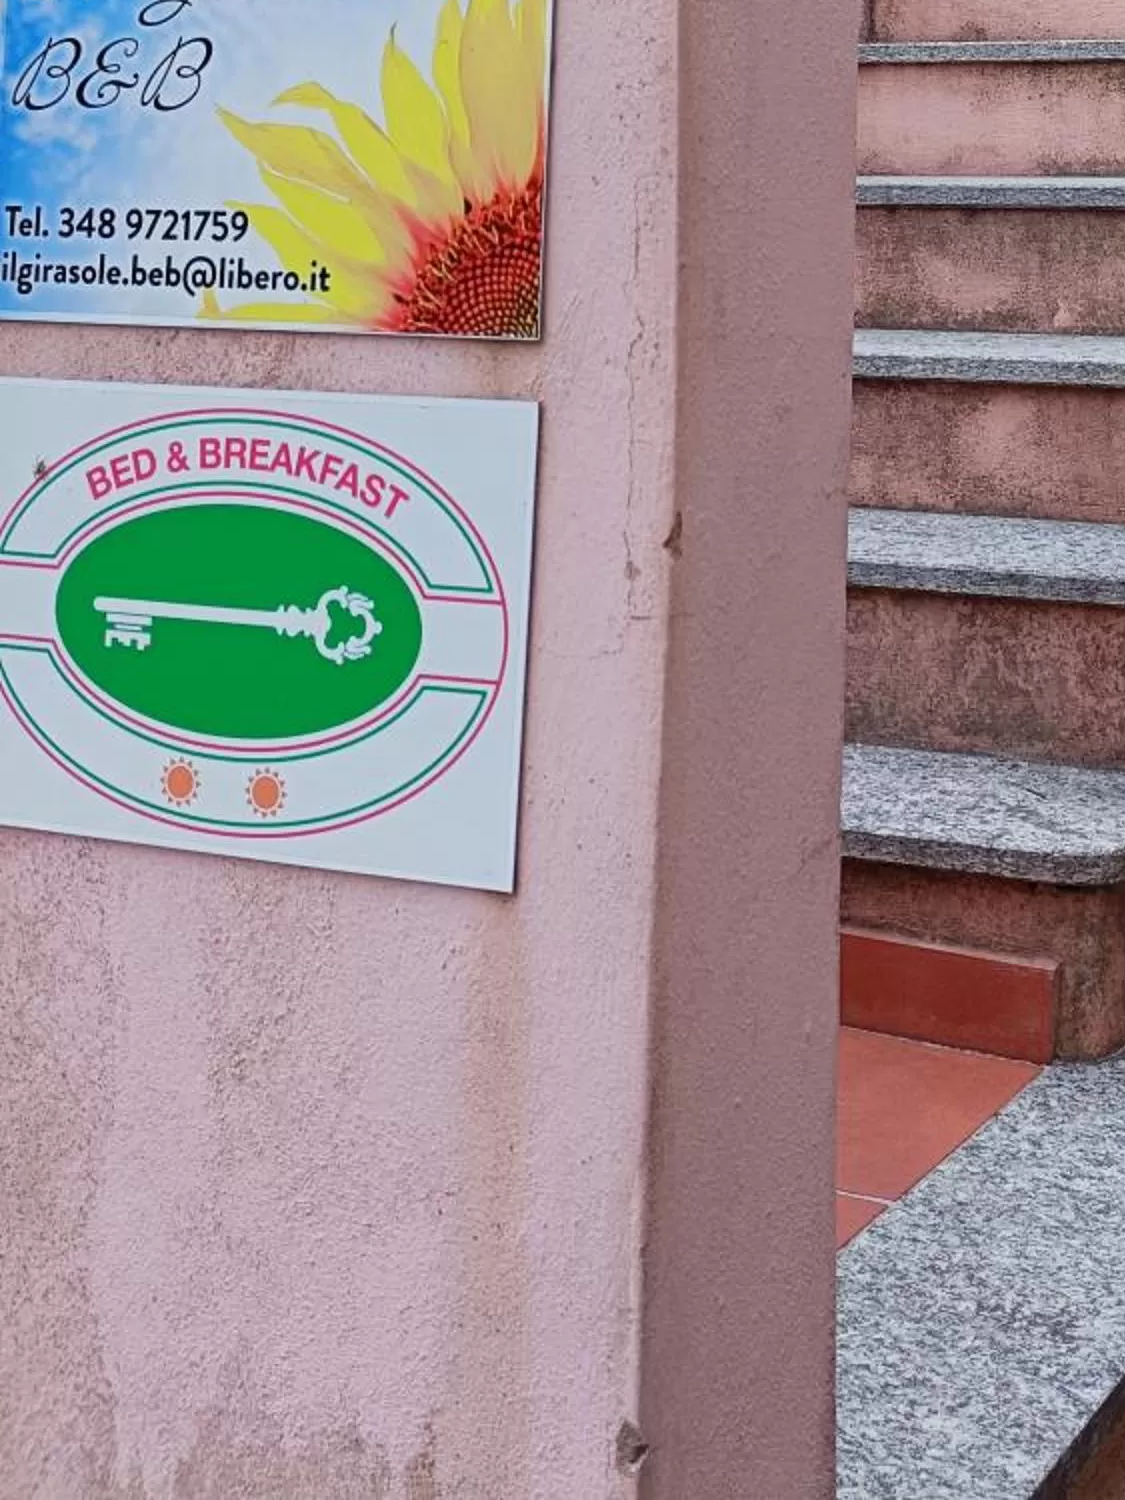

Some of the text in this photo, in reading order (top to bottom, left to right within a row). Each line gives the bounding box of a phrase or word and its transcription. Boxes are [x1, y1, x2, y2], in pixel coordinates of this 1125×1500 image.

[12, 35, 213, 111] B&B
[5, 205, 249, 242] Tel. 348 9721759
[1, 252, 332, 297] ilgirasole.beb@libero.it
[86, 437, 410, 519] BED & BREAKFAST
